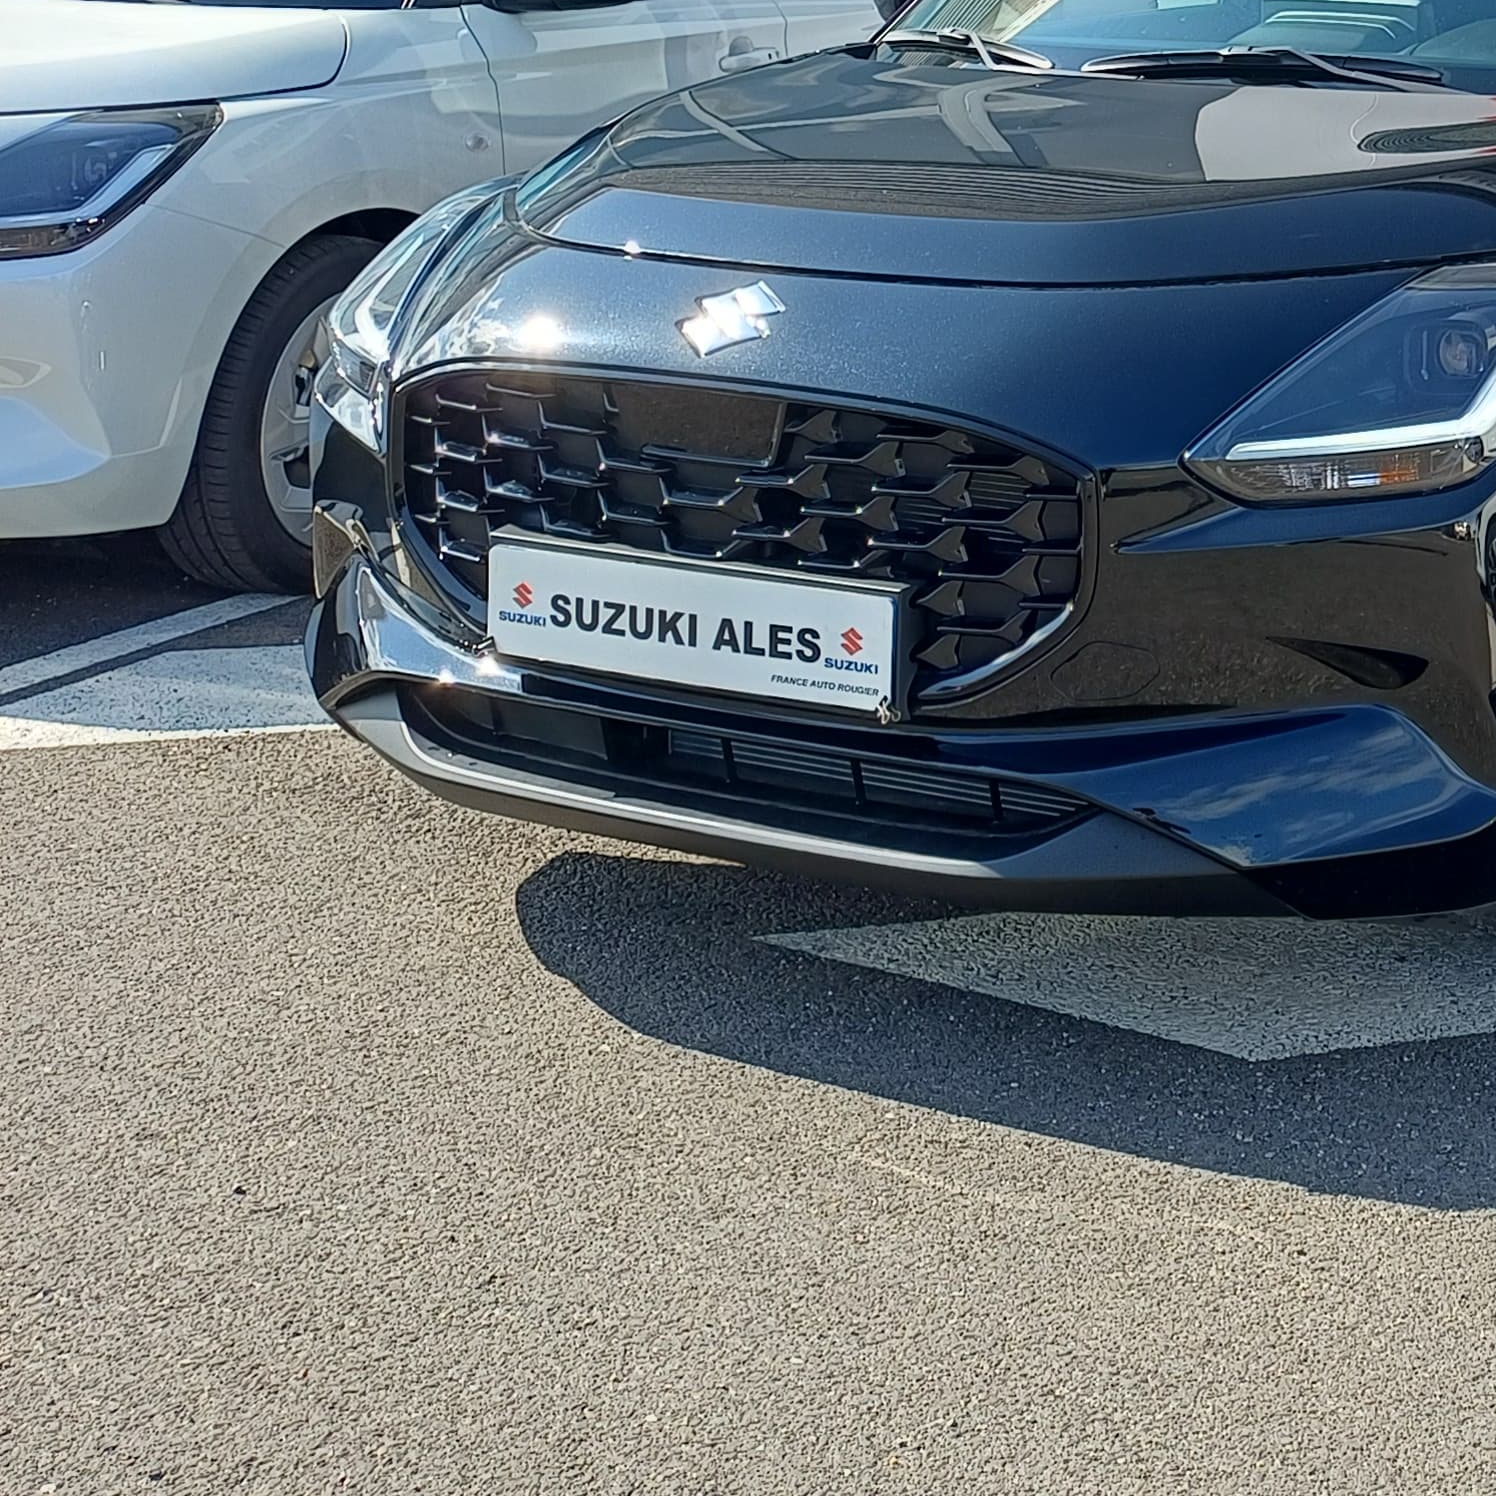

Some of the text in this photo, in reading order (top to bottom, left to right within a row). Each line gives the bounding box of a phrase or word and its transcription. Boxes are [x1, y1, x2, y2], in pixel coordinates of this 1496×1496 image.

[498, 610, 546, 627] SUZUKI
[550, 594, 821, 663] SUZUKI ALES
[824, 657, 879, 674] SUZUKI
[771, 674, 880, 697] FRANCE AUTO ROUGIER
